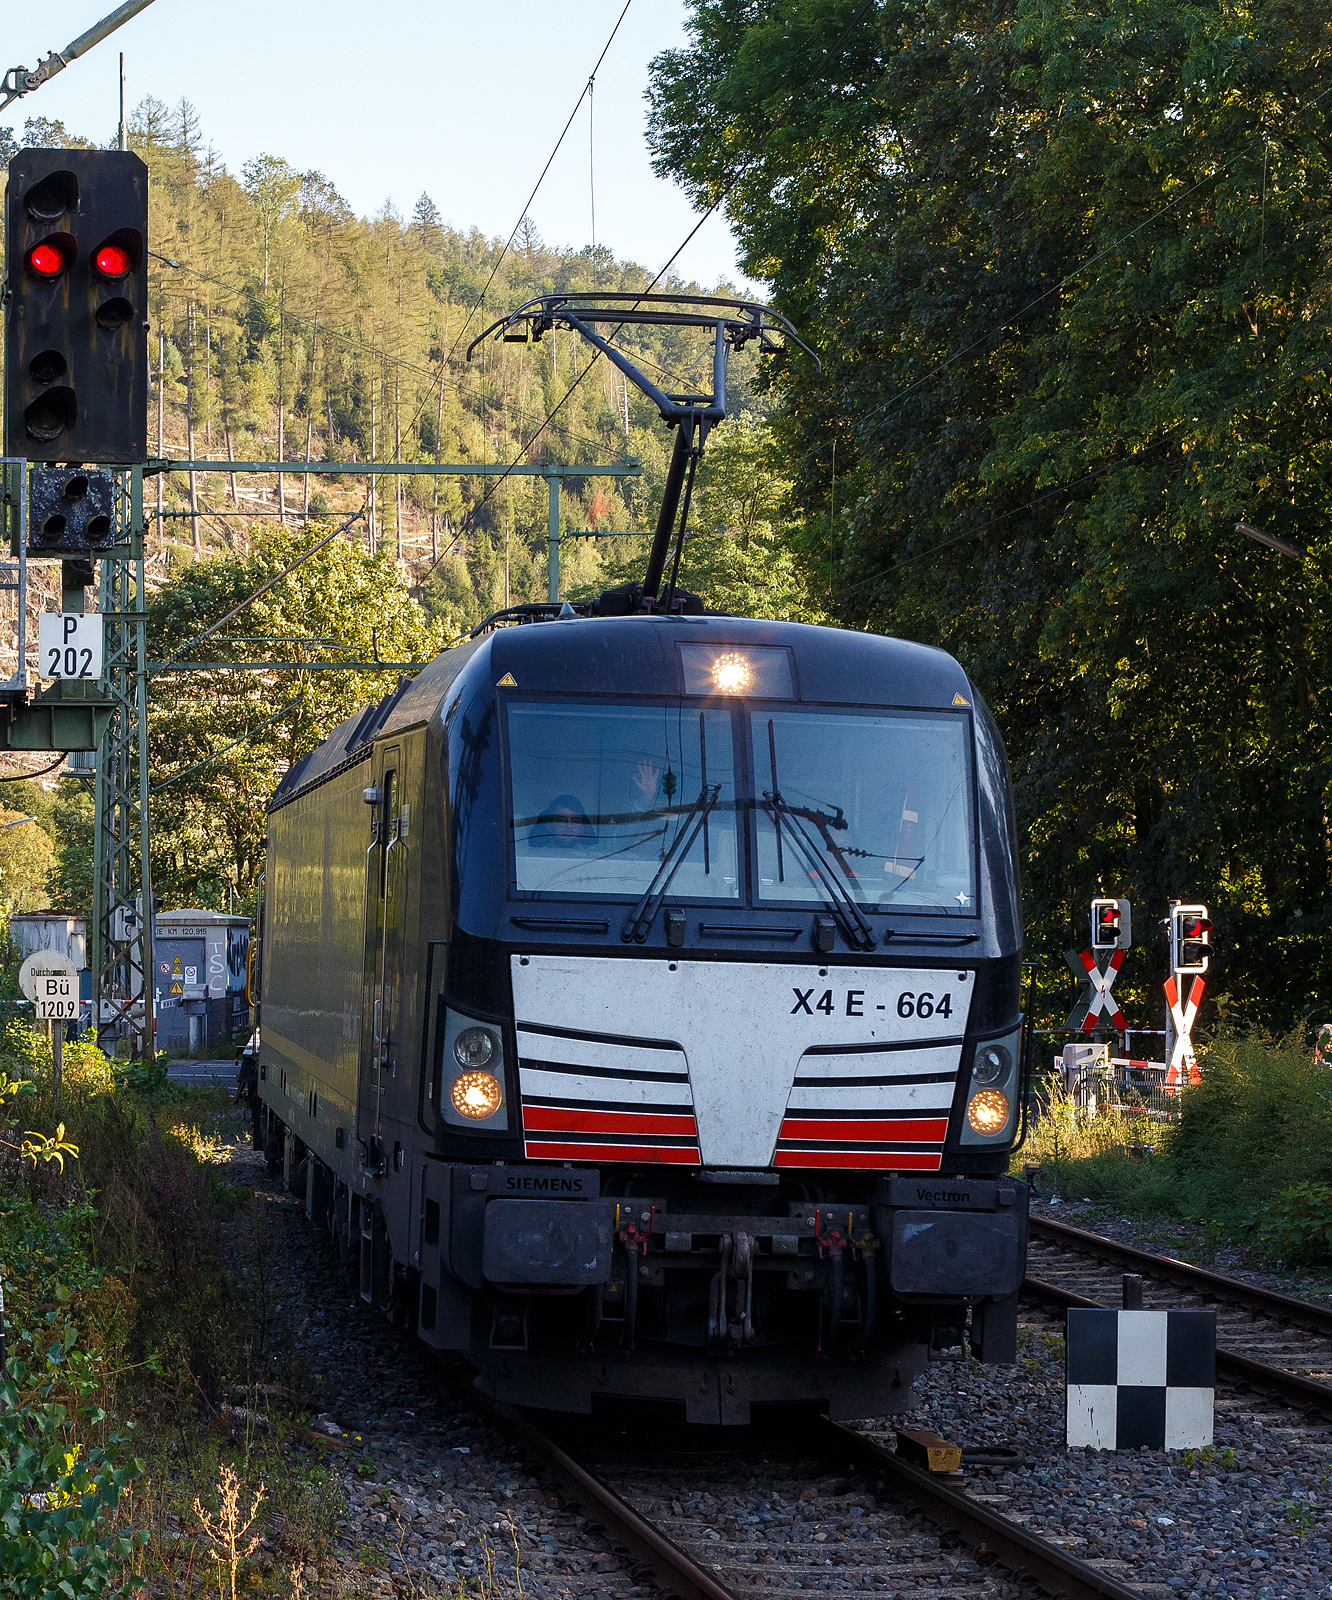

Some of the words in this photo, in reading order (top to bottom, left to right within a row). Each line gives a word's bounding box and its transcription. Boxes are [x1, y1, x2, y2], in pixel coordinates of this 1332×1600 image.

[63, 616, 78, 645] P
[47, 647, 93, 677] 202
[182, 927, 207, 936] 120,915
[46, 979, 70, 996] Bü
[40, 1000, 75, 1018] 120,9
[845, 990, 865, 1017] E
[896, 991, 953, 1019] 664
[506, 1177, 583, 1192] SIEMENS
[916, 1189, 970, 1203] Vectron
